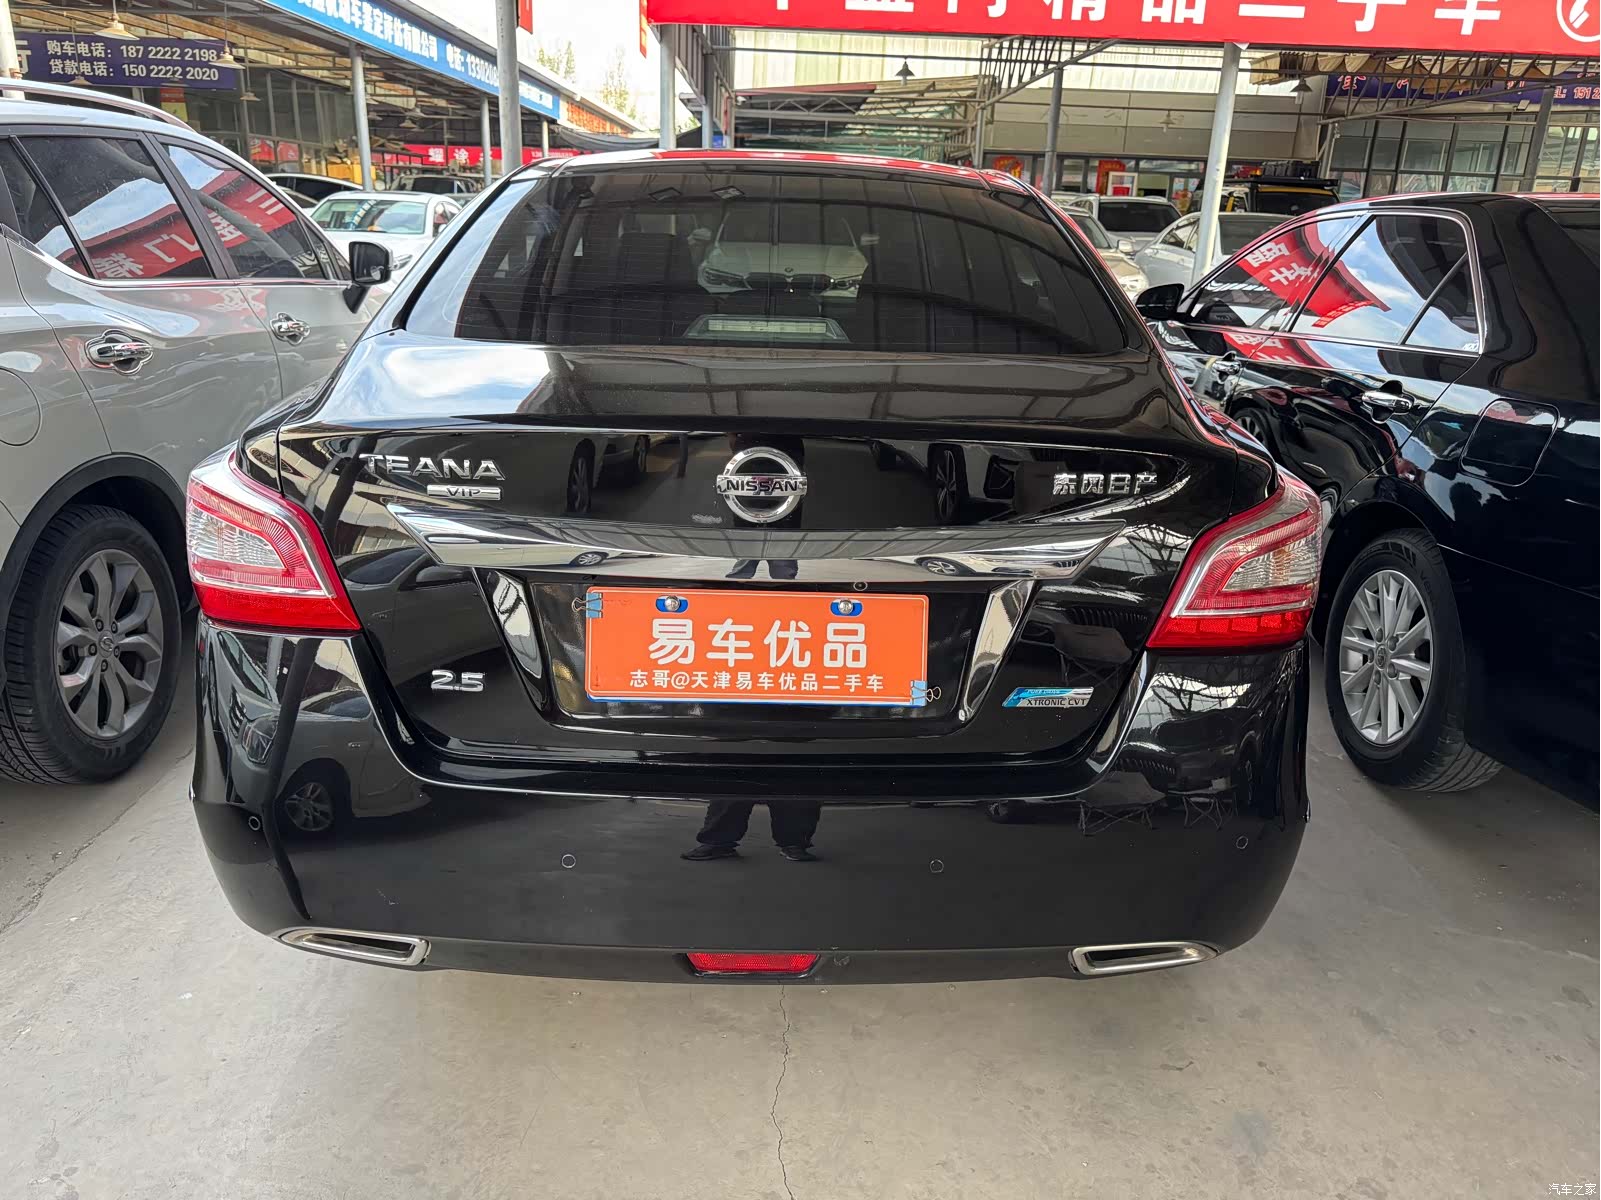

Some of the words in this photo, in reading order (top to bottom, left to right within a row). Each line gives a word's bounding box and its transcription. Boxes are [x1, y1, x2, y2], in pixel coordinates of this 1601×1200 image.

[120, 45, 144, 59] 187
[148, 46, 181, 60] 2222
[184, 48, 218, 62] 2198
[122, 64, 147, 77] 150
[150, 65, 183, 79] 2222
[186, 67, 219, 81] 2020
[359, 453, 506, 481] TEANA
[445, 487, 482, 497] VIP
[726, 479, 798, 492] NISSAN
[1053, 471, 1158, 495] 东风日产
[648, 618, 868, 669] 易车优品
[431, 669, 484, 692] 2.5
[629, 669, 884, 693] 志哥@天津易车优品二手车
